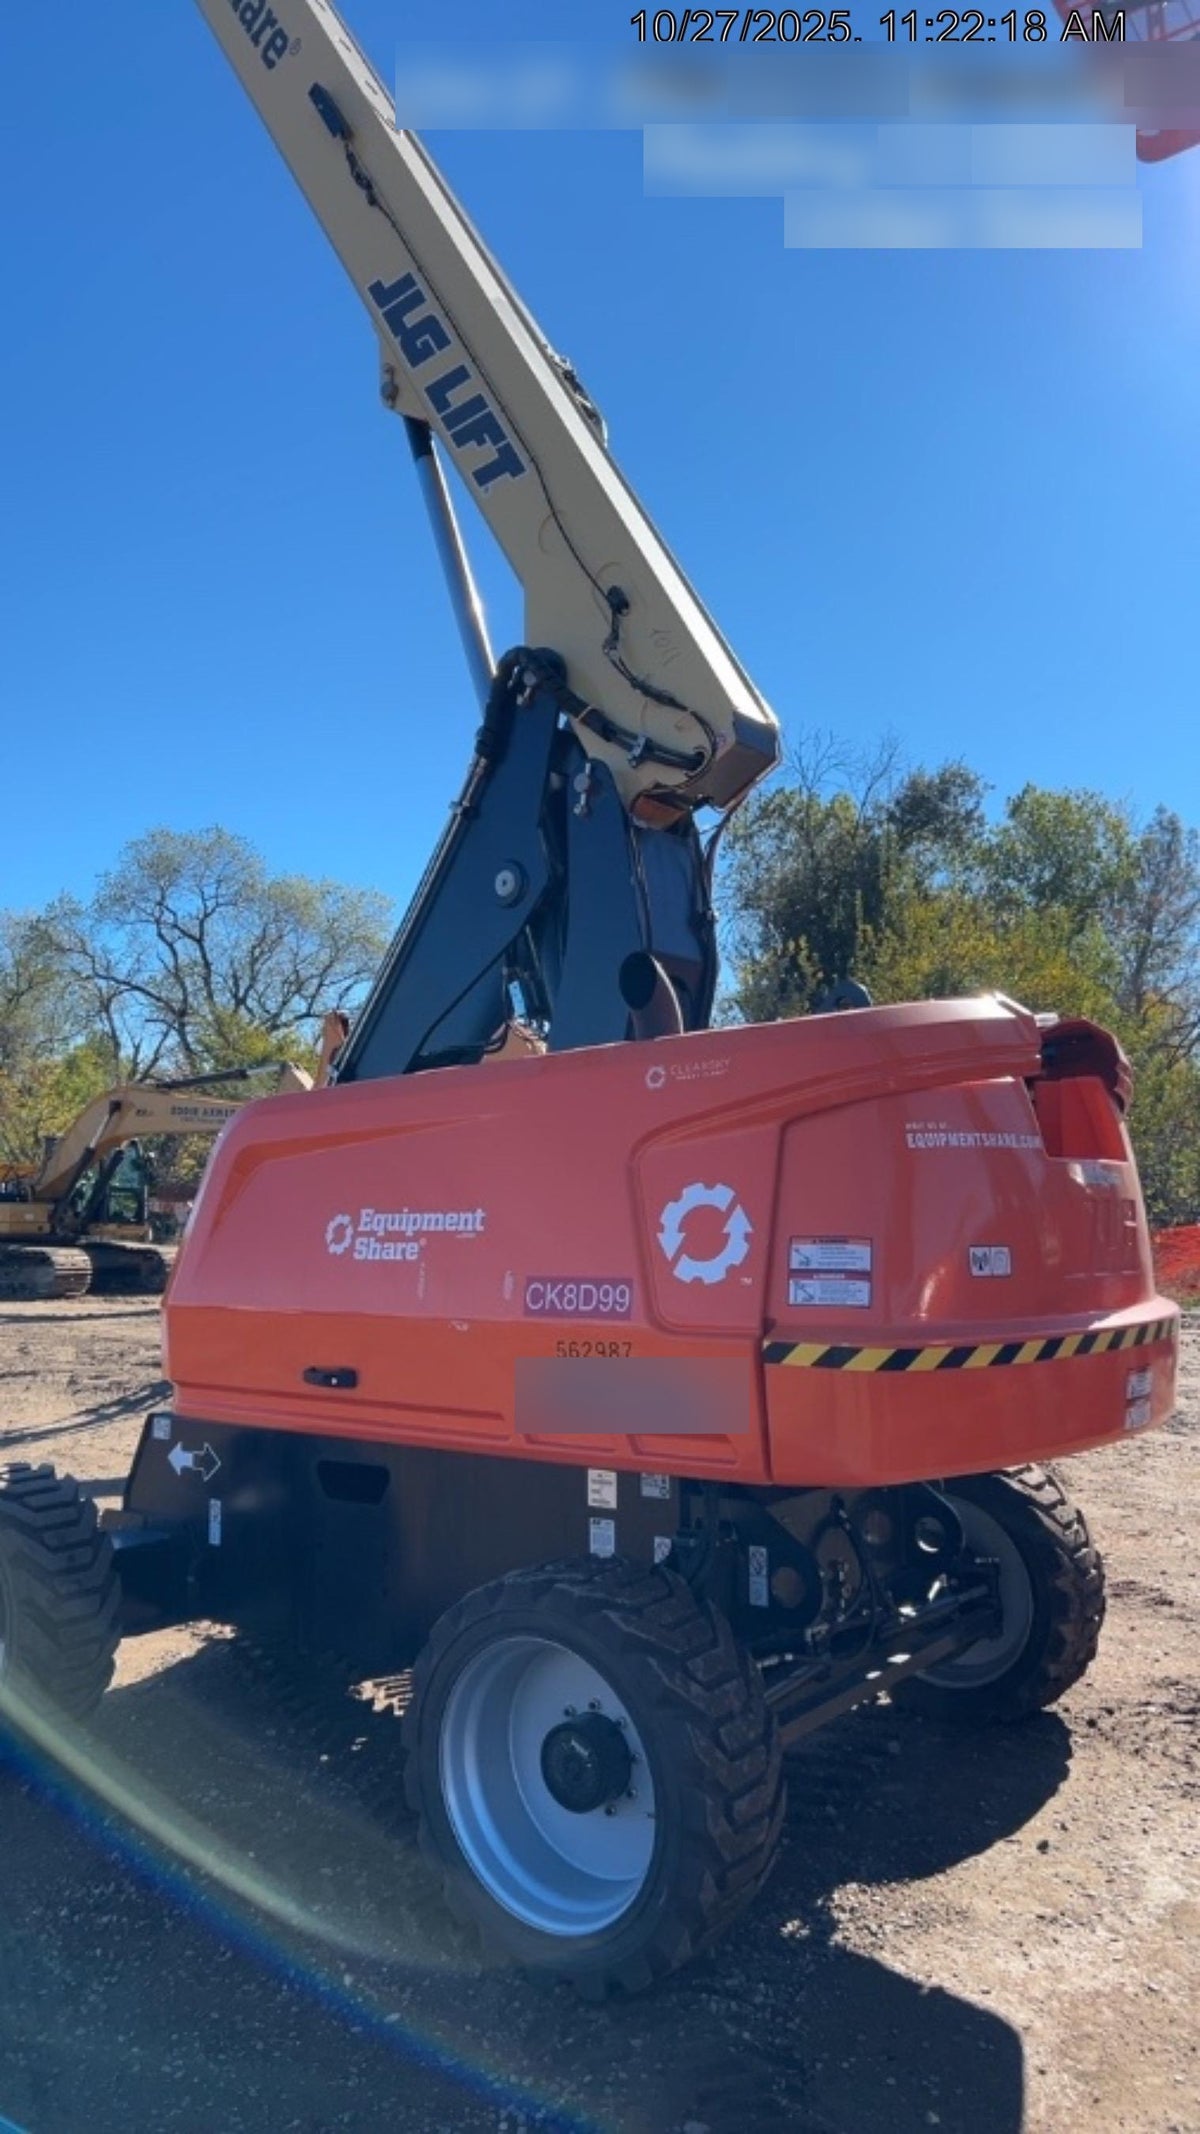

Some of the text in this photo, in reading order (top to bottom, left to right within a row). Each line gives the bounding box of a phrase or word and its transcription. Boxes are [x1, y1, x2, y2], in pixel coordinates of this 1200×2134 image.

[367, 271, 527, 488] JLG LIFT
[358, 1207, 486, 1237] Equipment
[353, 1237, 419, 1260] Share
[526, 1282, 630, 1312] CK8D99
[556, 1341, 632, 1358] 562987
